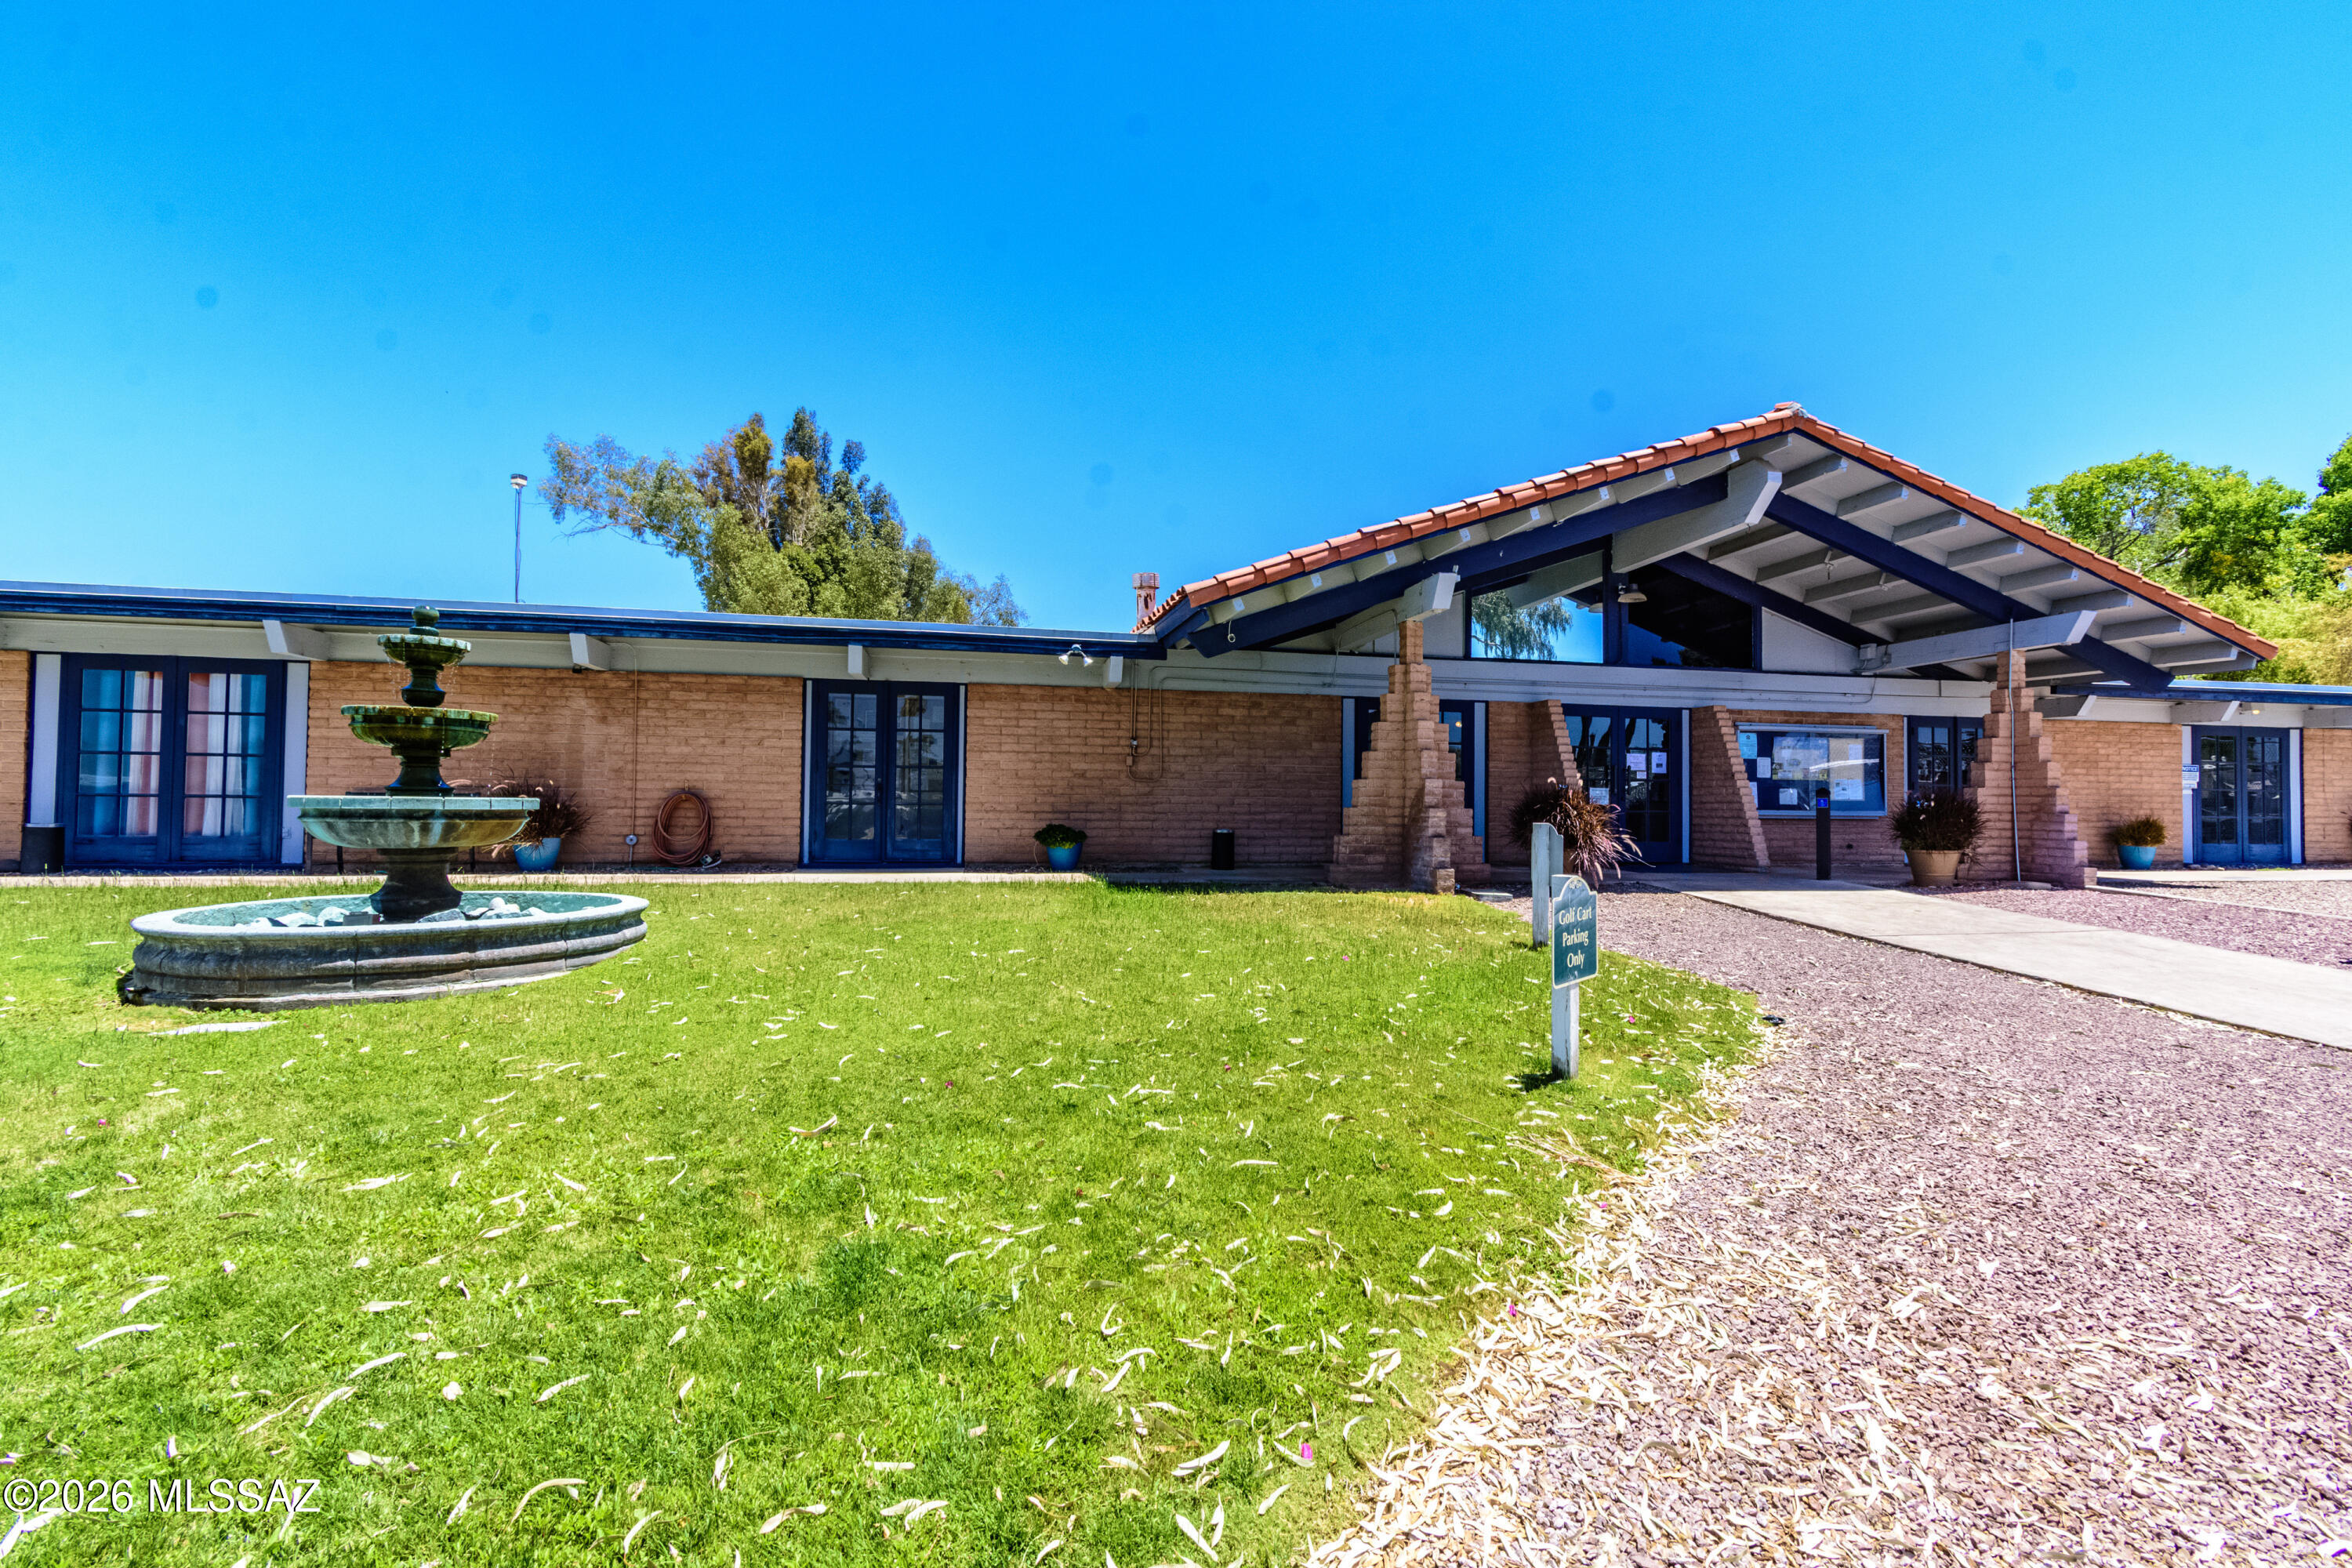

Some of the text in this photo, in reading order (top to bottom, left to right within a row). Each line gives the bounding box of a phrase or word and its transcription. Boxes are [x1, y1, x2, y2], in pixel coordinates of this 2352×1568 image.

[1559, 906, 1592, 925] Golf Cart
[1563, 928, 1589, 947] Parking
[1567, 949, 1585, 969] Only
